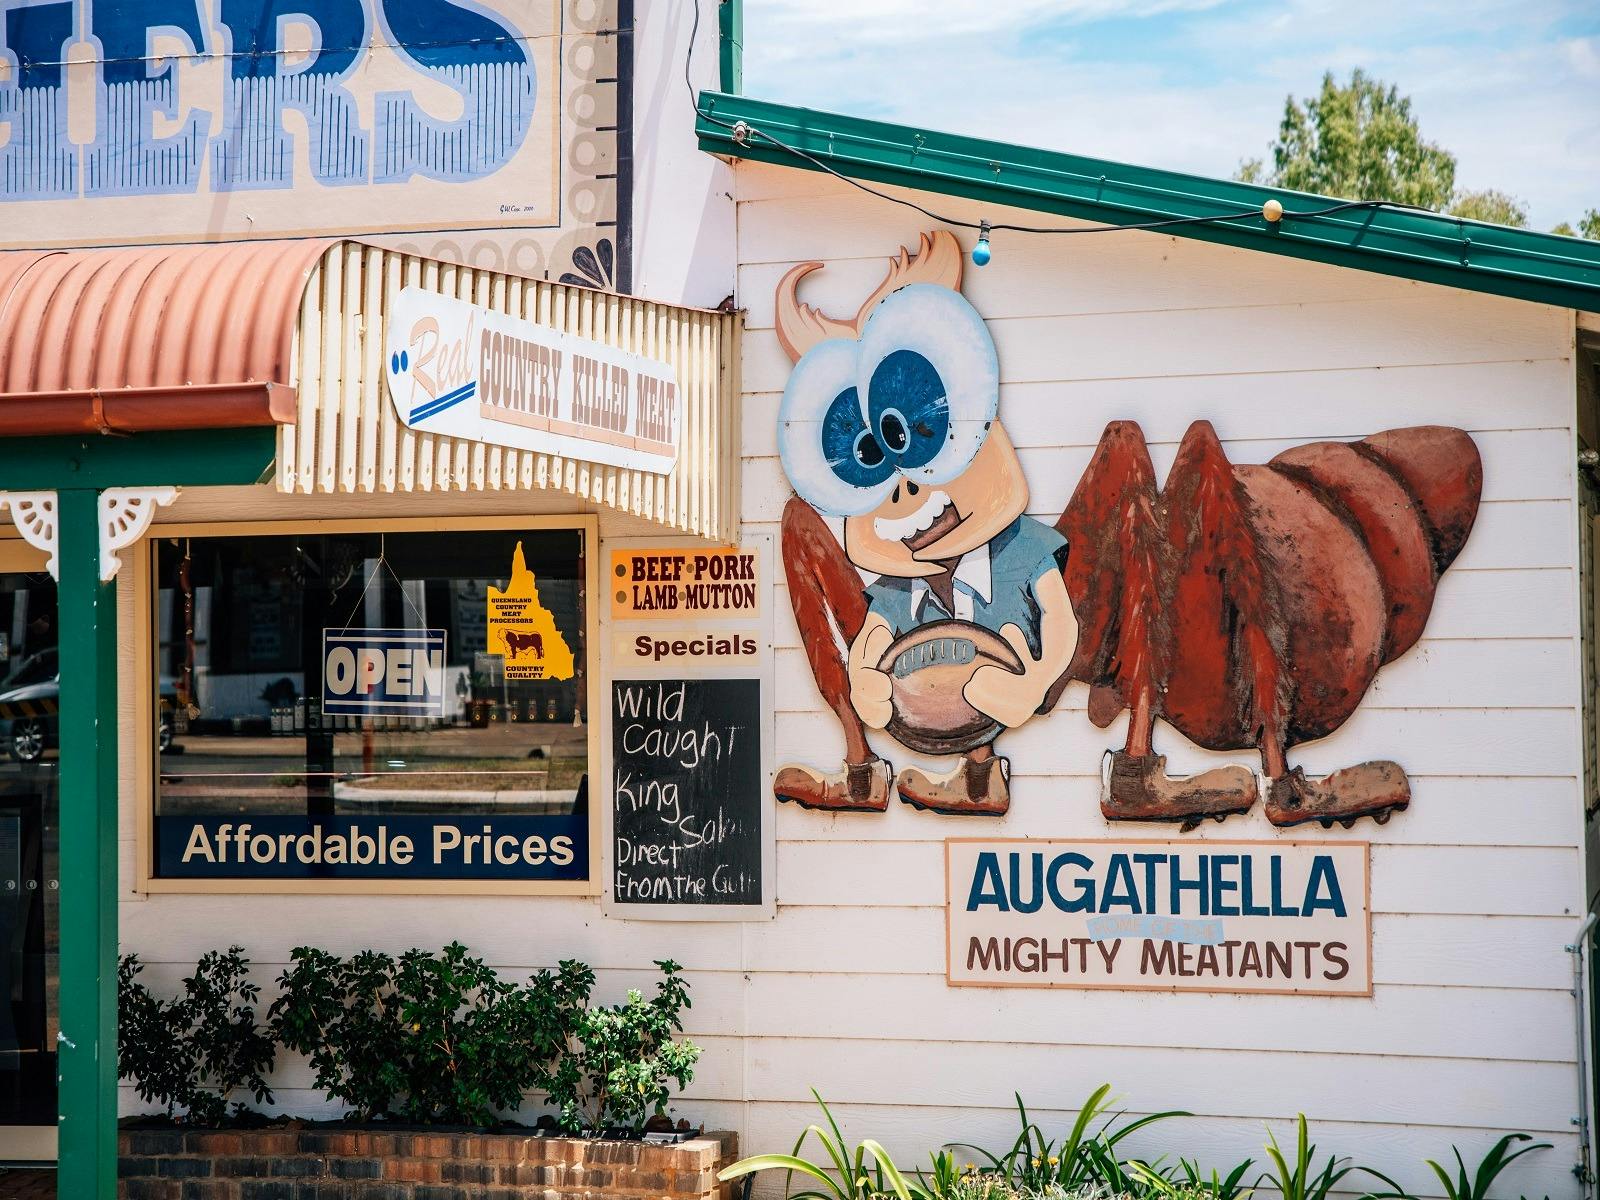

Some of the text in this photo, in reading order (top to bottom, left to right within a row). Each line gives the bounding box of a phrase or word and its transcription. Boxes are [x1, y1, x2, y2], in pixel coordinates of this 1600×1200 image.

[410, 310, 474, 404] Real
[480, 328, 675, 443] COUNTRY KILLED MEAT
[631, 555, 755, 581] BEEF PORK
[633, 584, 756, 610] LAMB MUTTON
[634, 635, 757, 661] Specials
[326, 646, 443, 696] OPEN
[617, 682, 686, 722] Wild
[615, 768, 681, 824] King
[182, 824, 574, 866] Affordable Prices
[617, 836, 683, 869] Direct
[966, 852, 1348, 918] AUGATHELLA
[967, 936, 1351, 981] MIGHTY MEATANTS
